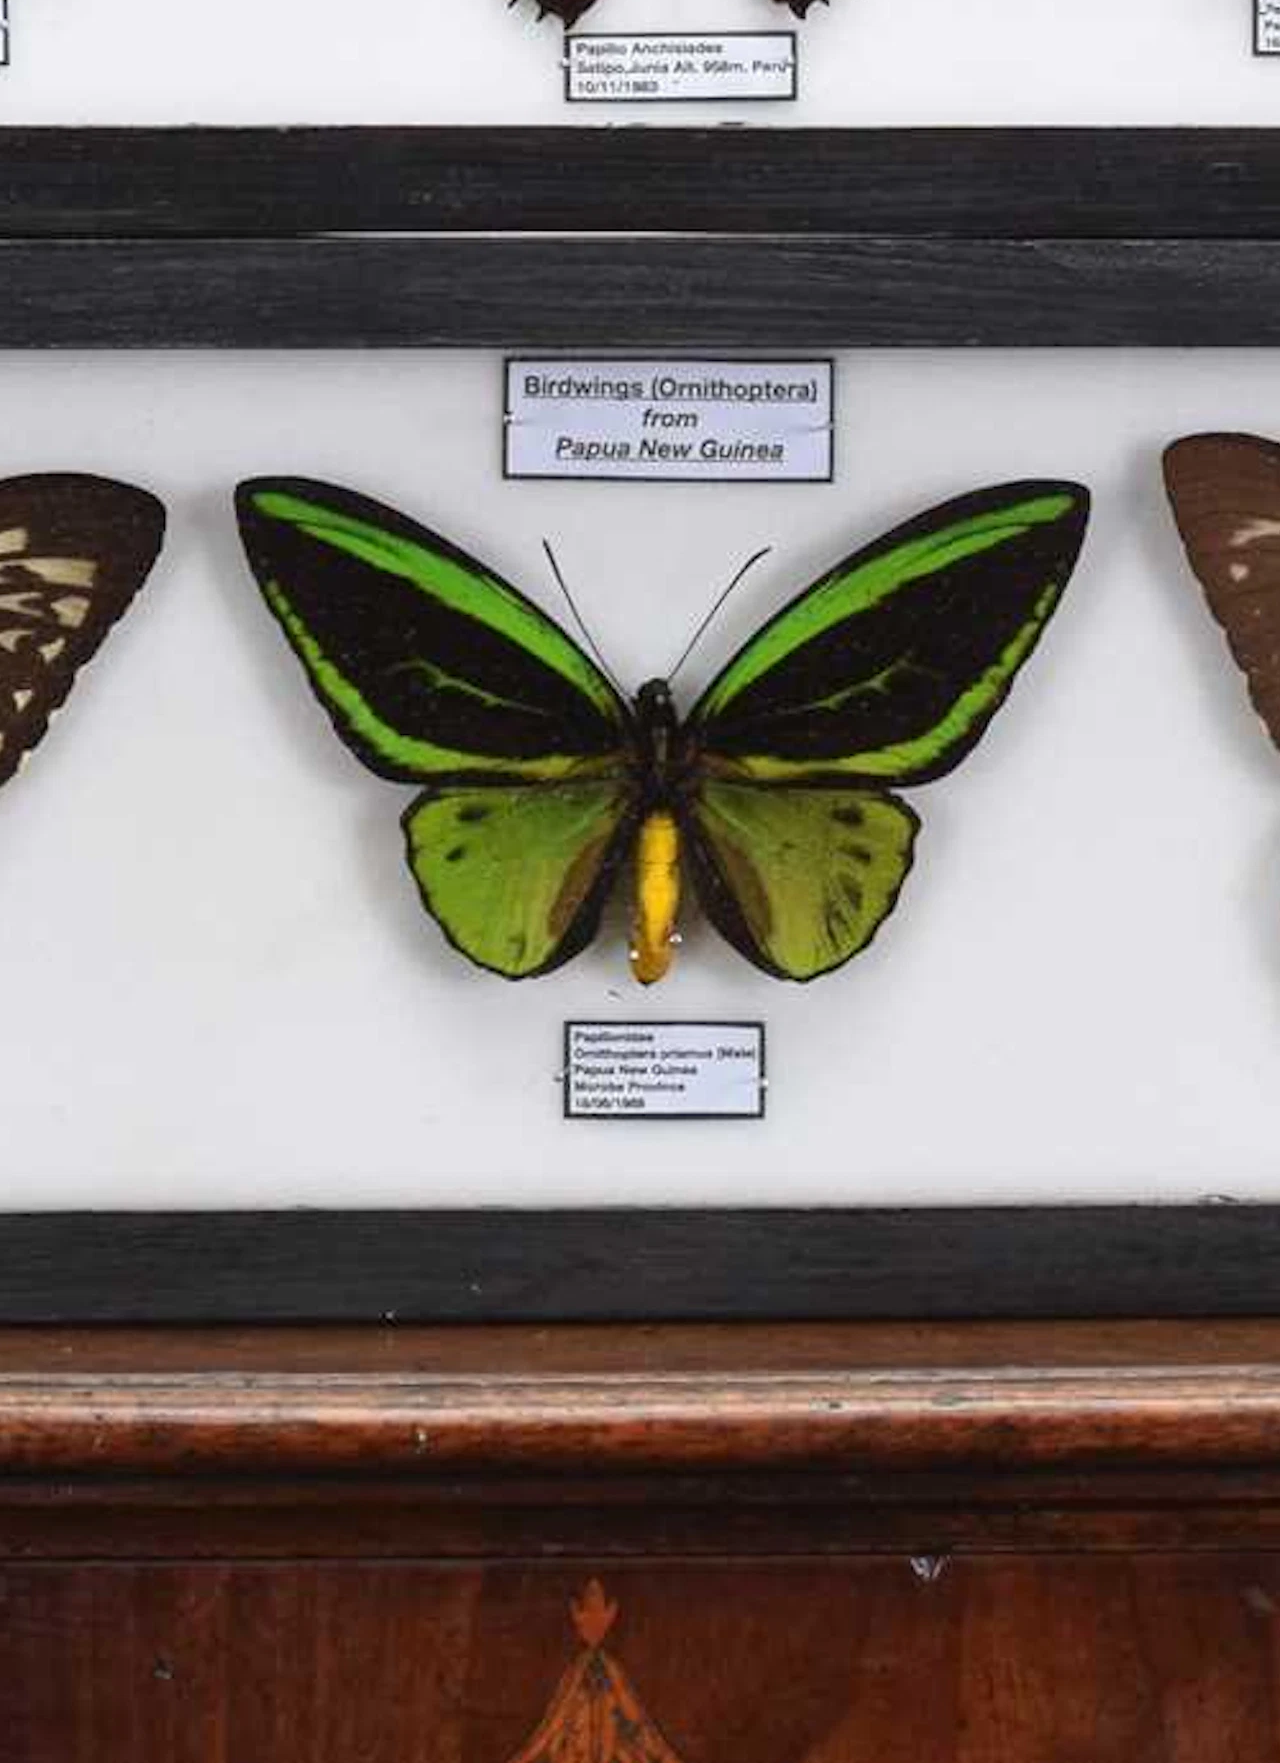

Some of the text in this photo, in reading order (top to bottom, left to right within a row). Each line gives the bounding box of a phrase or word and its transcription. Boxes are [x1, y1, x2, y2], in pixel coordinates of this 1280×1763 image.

[523, 375, 817, 403] Birdwings (Ornithoptera)
[642, 408, 698, 428] from
[555, 437, 784, 461] Papua New Guinea
